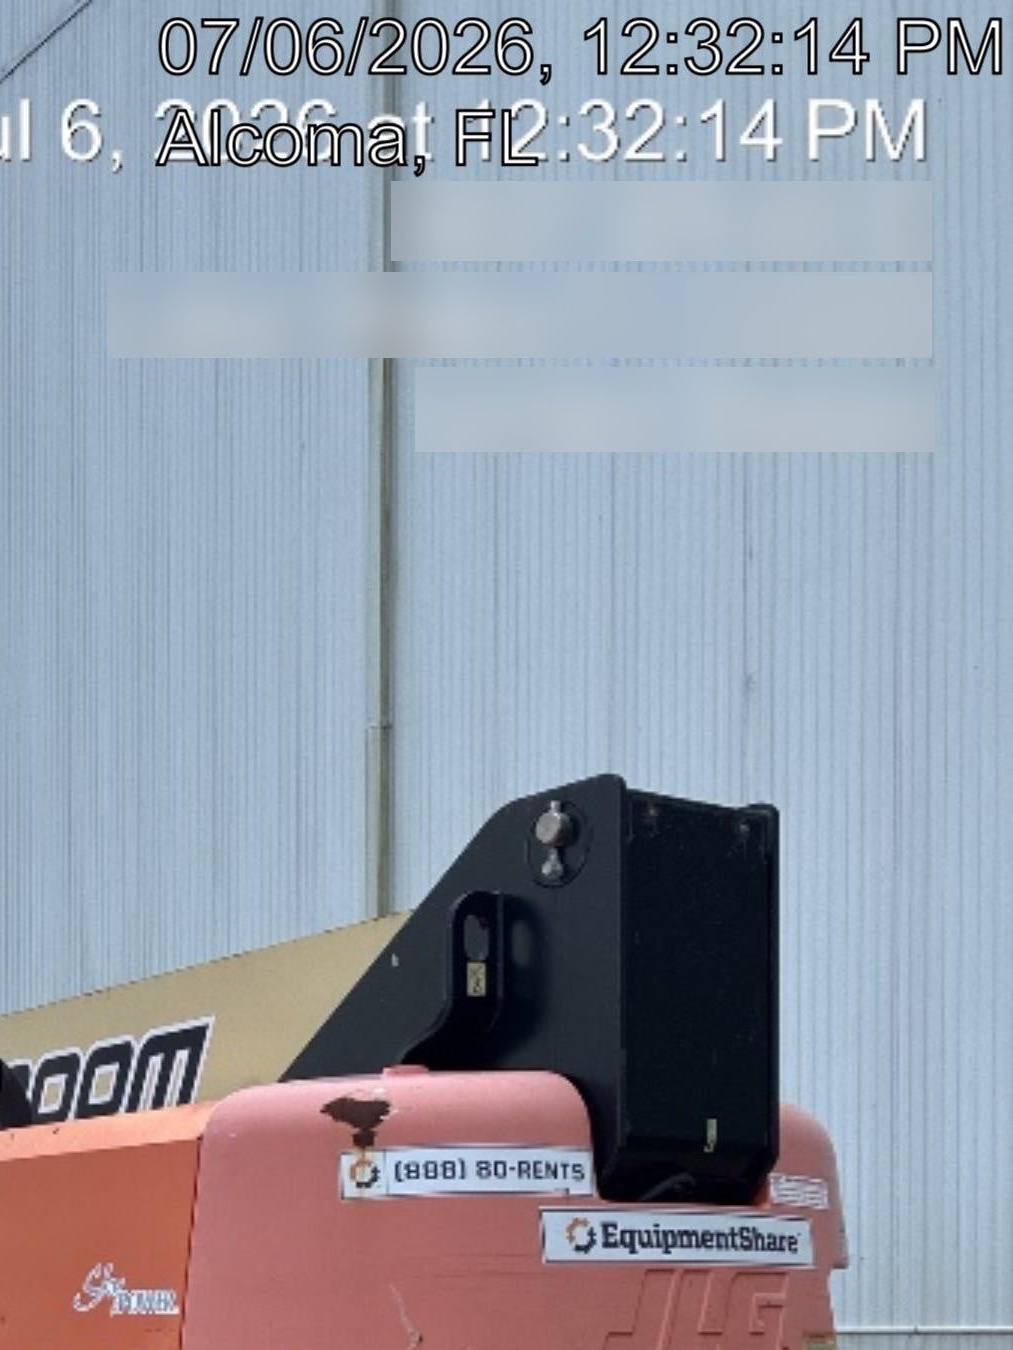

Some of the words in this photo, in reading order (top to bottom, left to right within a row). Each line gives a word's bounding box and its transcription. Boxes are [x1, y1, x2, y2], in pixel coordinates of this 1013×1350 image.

[394, 1158, 466, 1182] (888)
[475, 1160, 586, 1181] 80-RENTS
[601, 1221, 799, 1254] EquipmentShare
